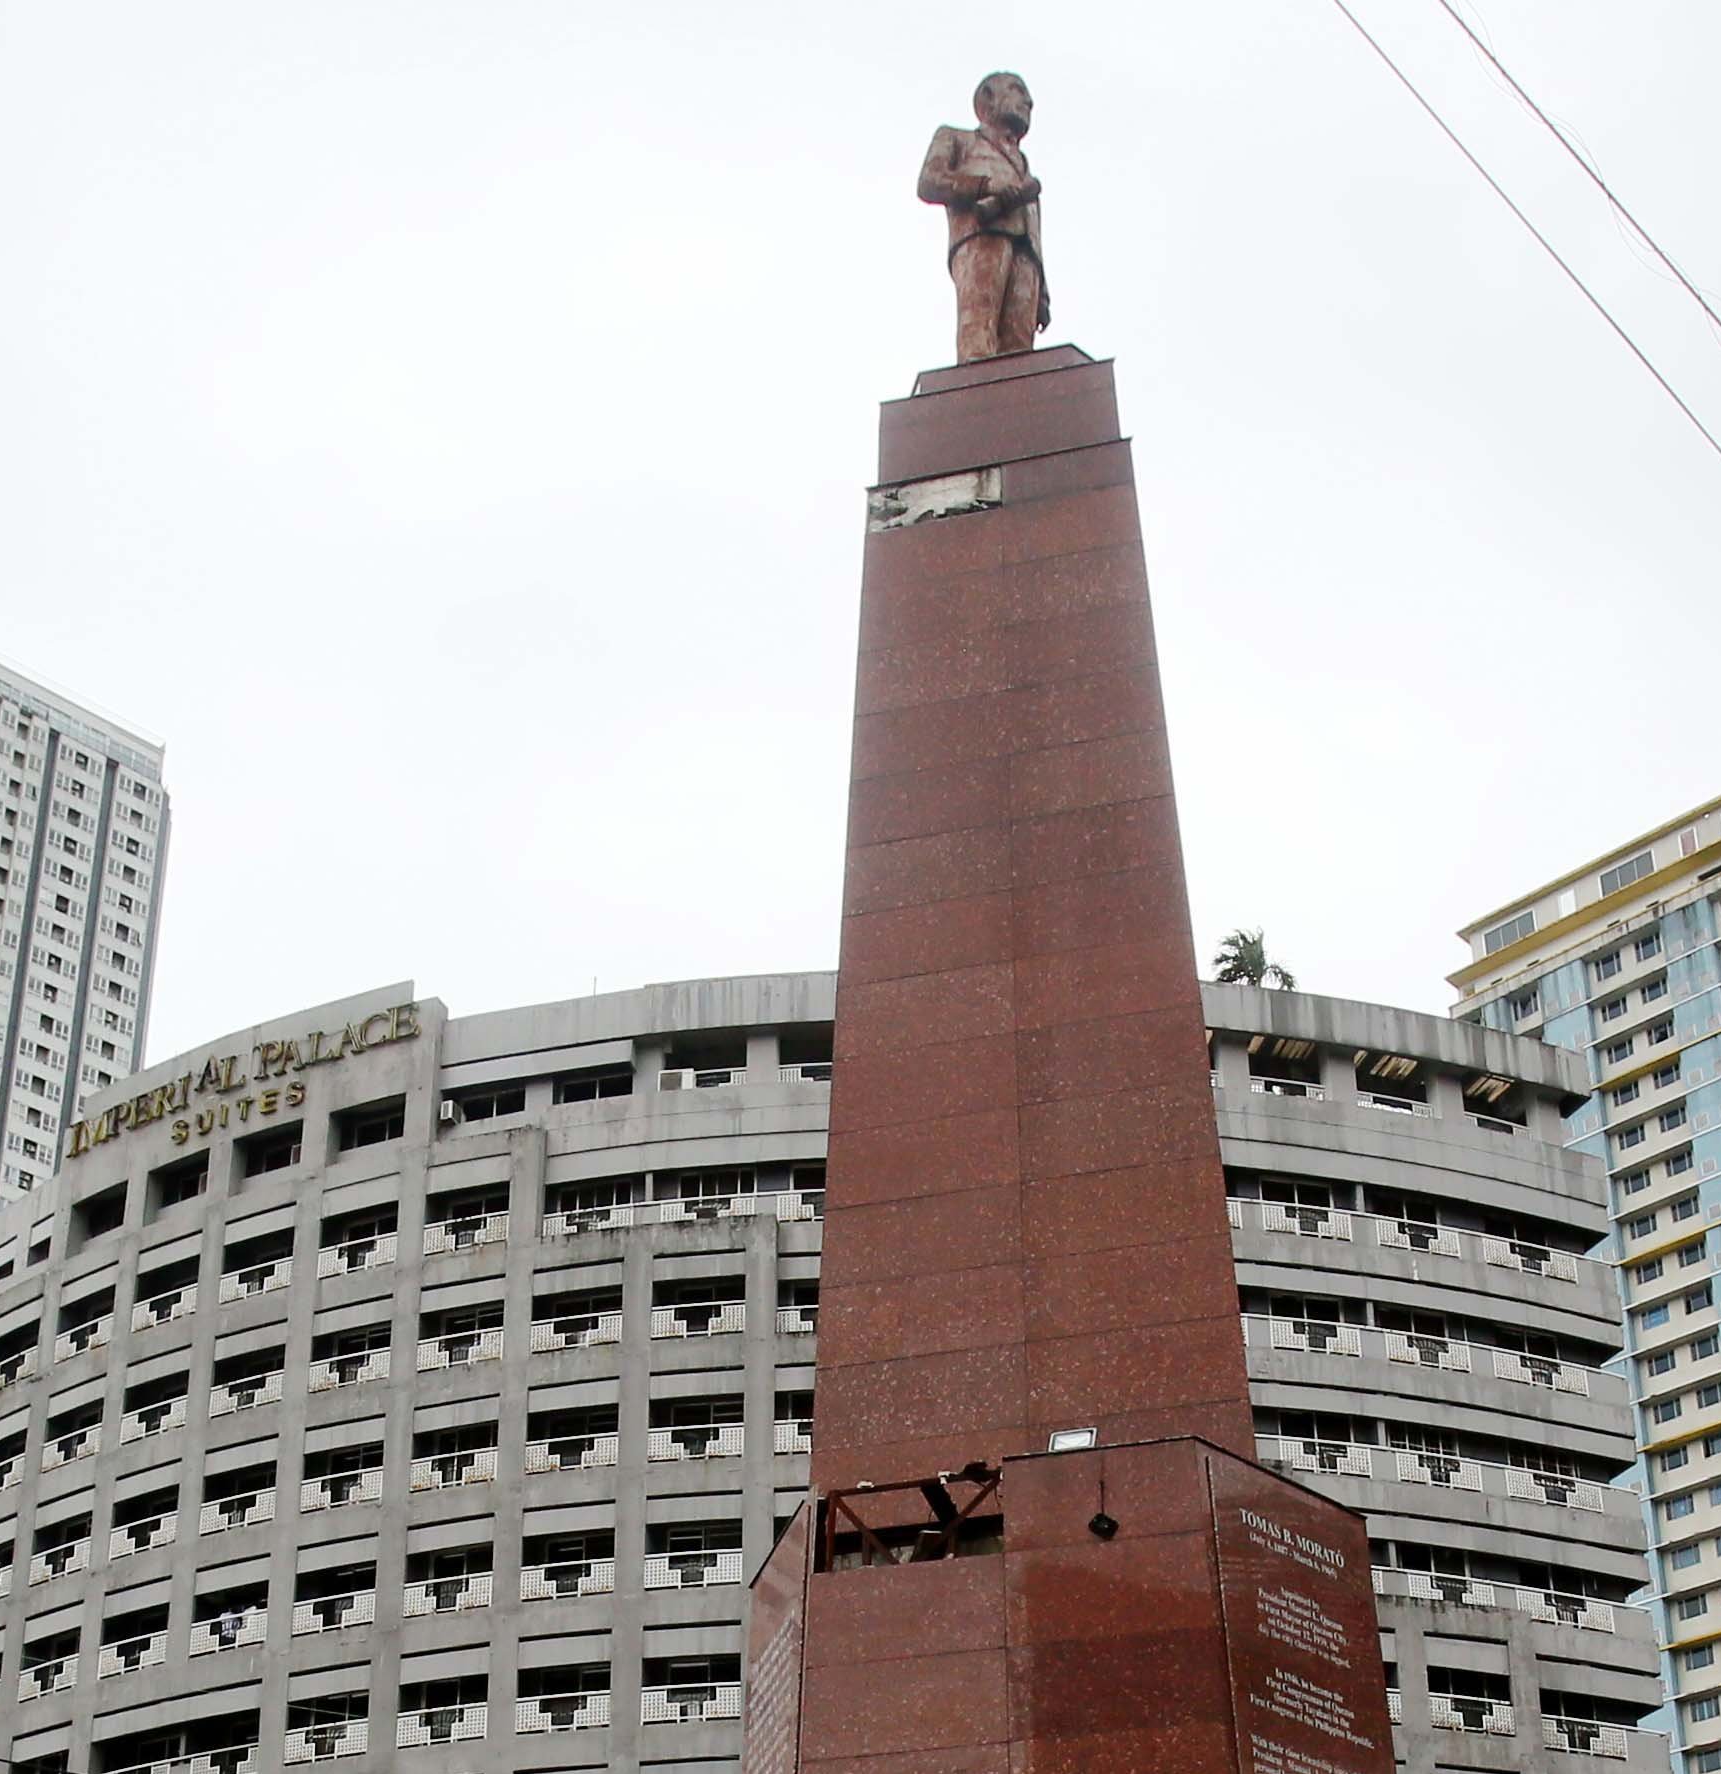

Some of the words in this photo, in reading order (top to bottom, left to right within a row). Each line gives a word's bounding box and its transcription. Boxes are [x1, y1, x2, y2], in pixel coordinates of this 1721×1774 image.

[66, 1054, 246, 1158] IMPERIAL
[253, 1002, 420, 1080] PALACE
[171, 1081, 306, 1146] SUITES
[1283, 1528, 1295, 1546] B.
